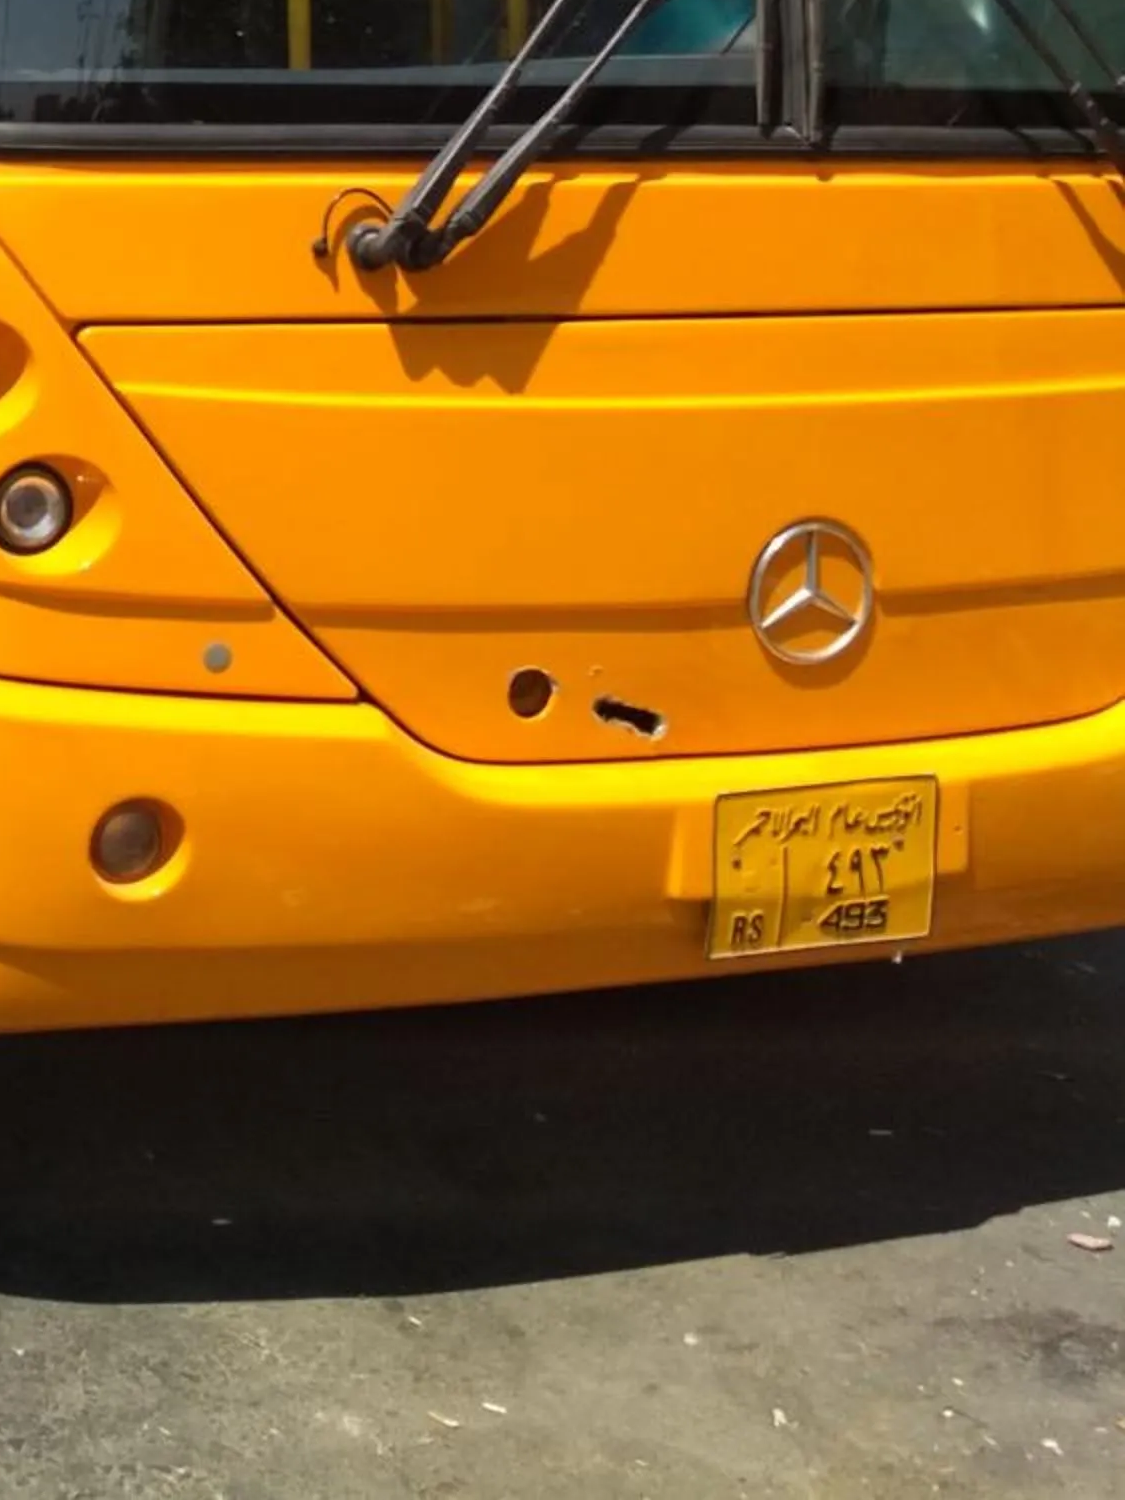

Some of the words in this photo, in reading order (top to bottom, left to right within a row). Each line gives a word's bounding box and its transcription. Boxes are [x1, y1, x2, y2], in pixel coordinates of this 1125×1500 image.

[826, 847, 890, 897] ٤٩٣
[731, 909, 765, 946] RS
[818, 900, 888, 931] 493
